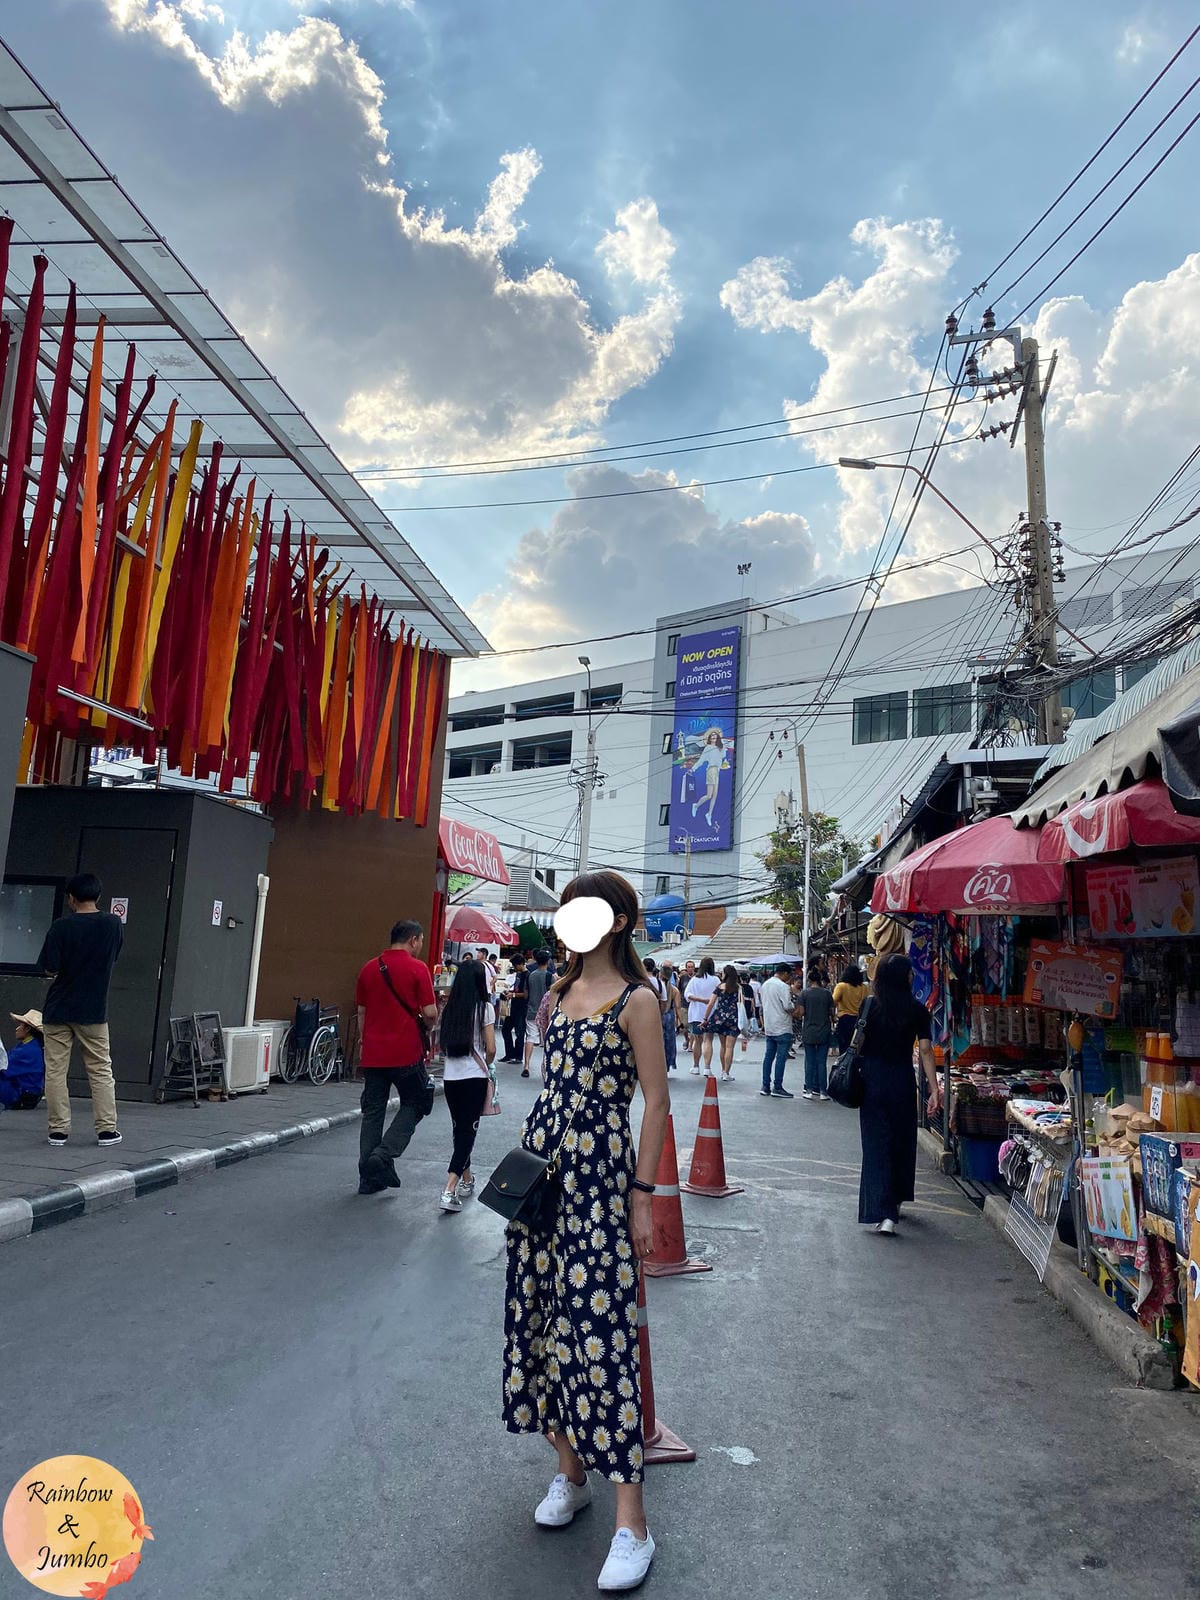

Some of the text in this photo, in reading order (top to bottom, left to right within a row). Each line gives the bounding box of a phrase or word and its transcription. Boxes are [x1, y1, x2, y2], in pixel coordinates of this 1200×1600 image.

[682, 645, 733, 664] NOW OPEN
[704, 669, 732, 683] จตุจักร
[449, 821, 501, 880] Coca-Cola
